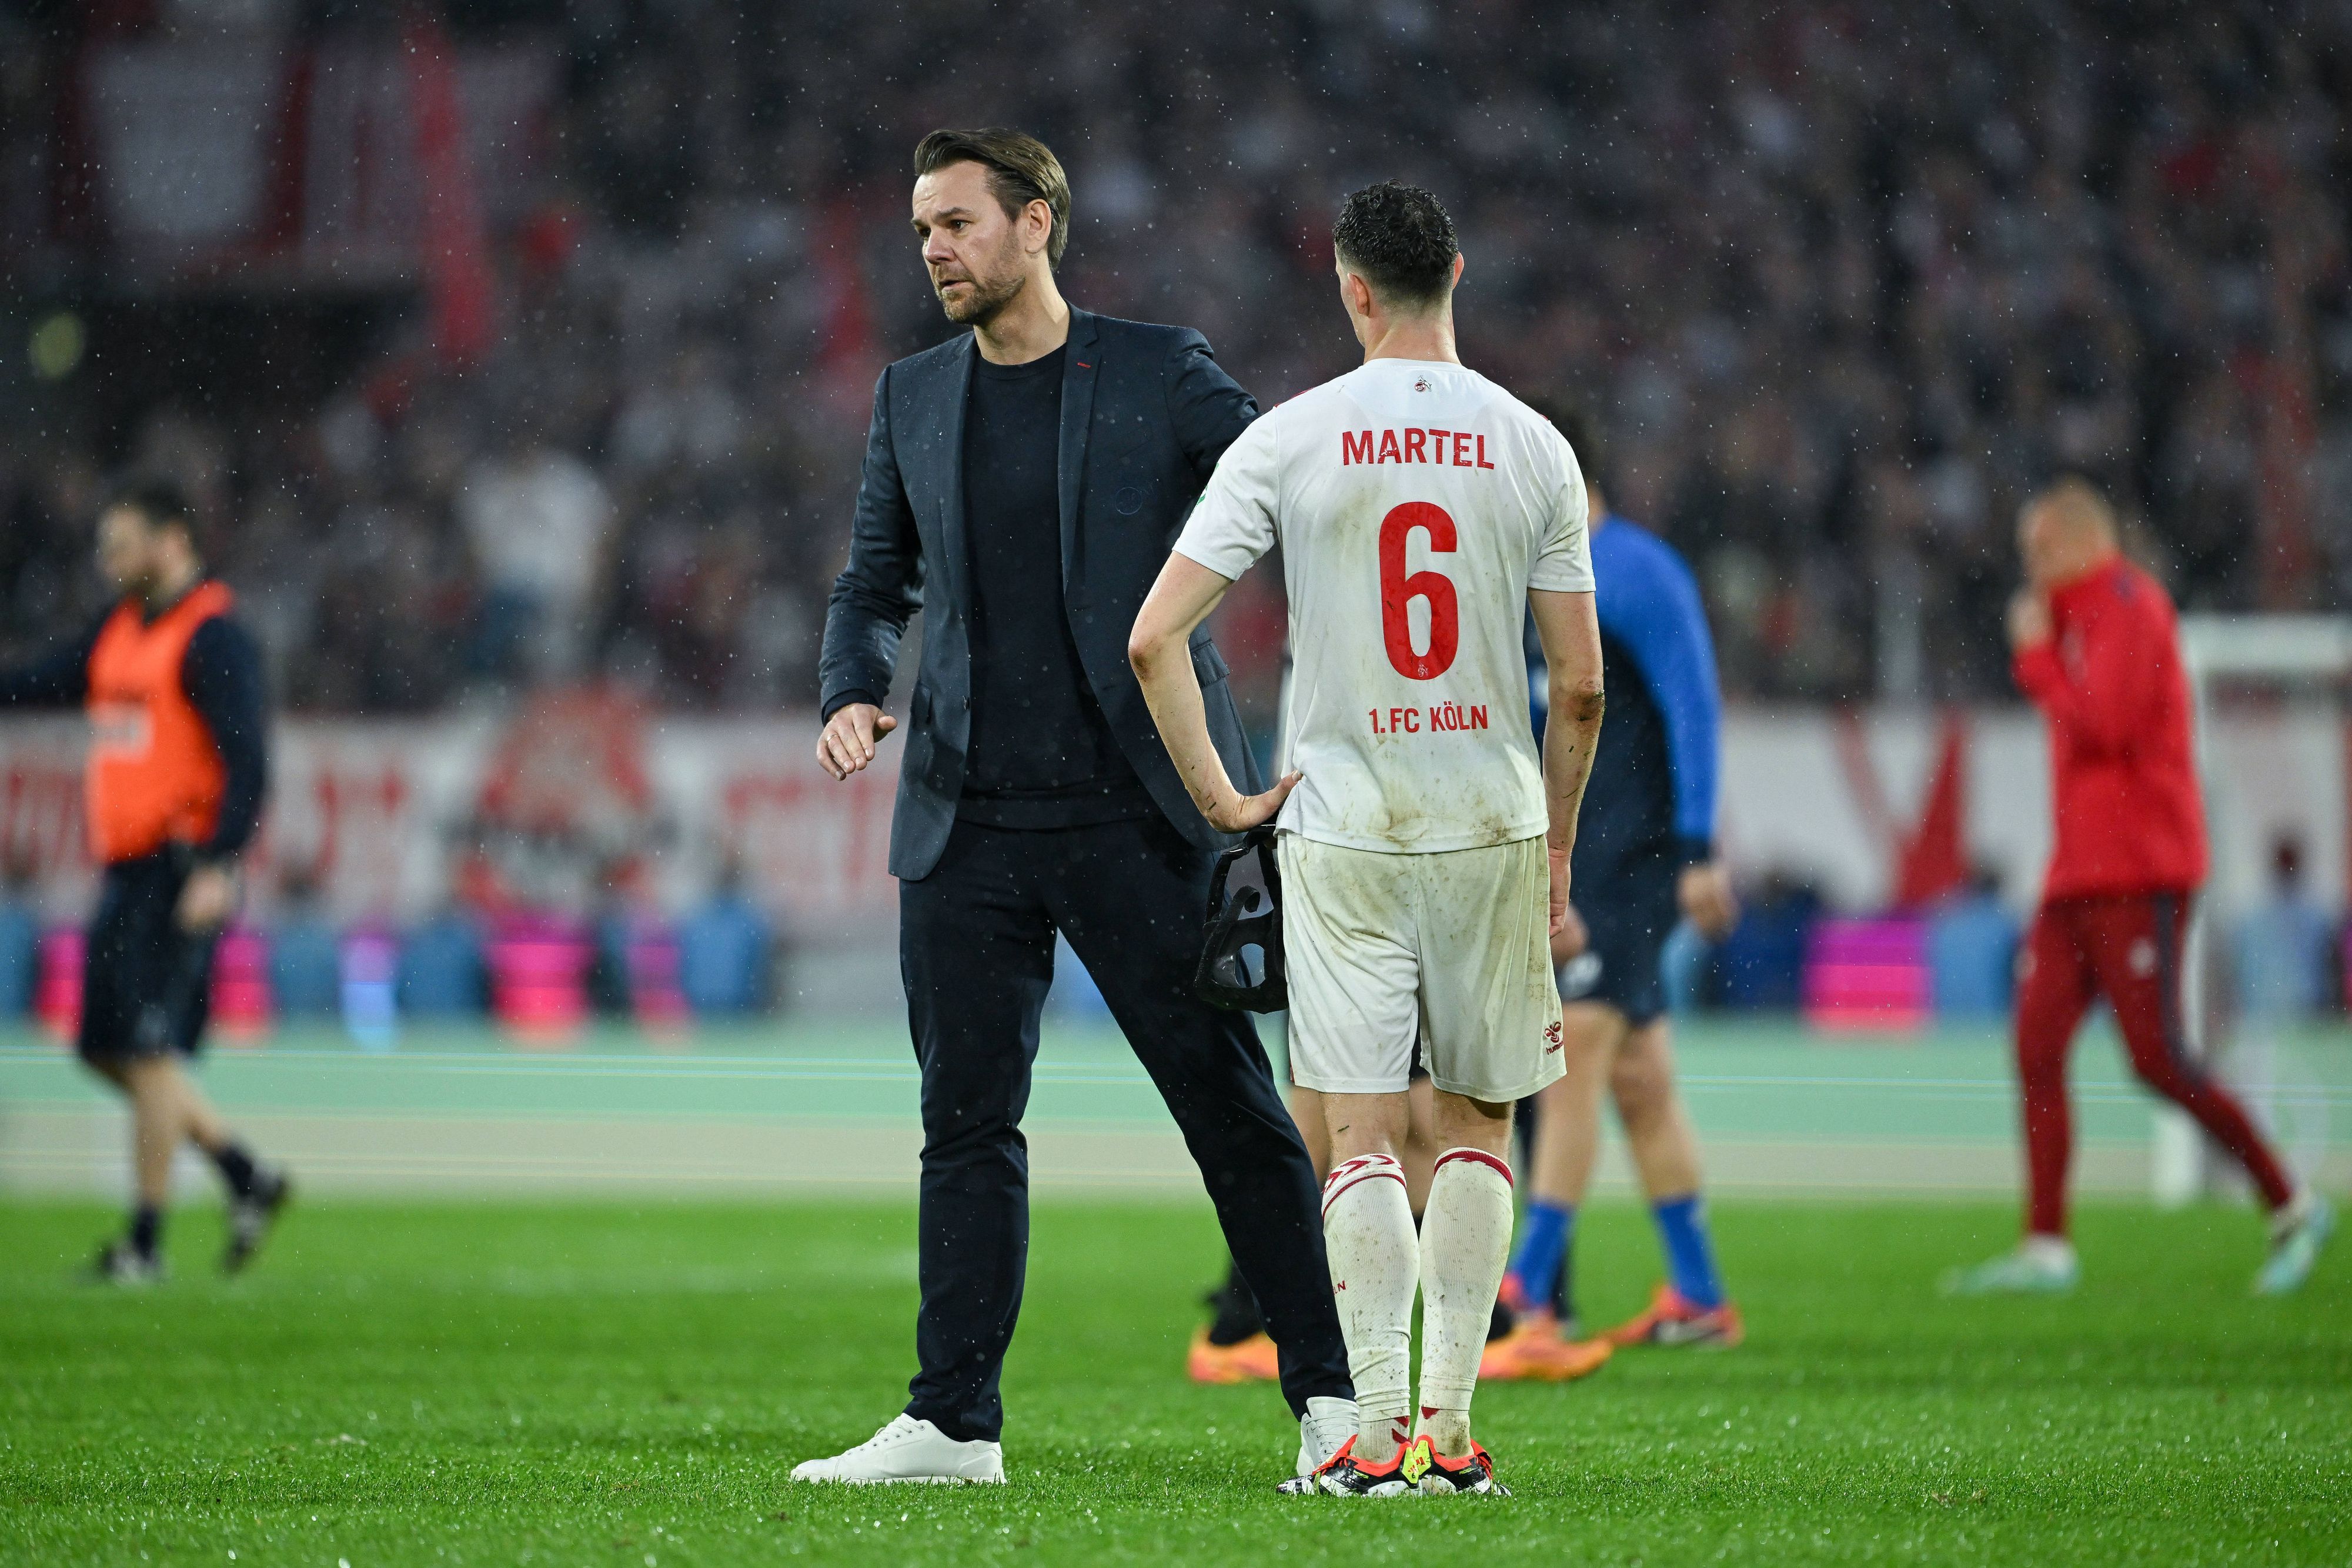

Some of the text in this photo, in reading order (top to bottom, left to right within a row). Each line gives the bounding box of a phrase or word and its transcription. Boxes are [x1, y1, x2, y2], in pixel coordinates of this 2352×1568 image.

[1342, 428, 1494, 469] MARTEL
[1379, 502, 1459, 680] 6
[1430, 701, 1488, 731] KÖLN
